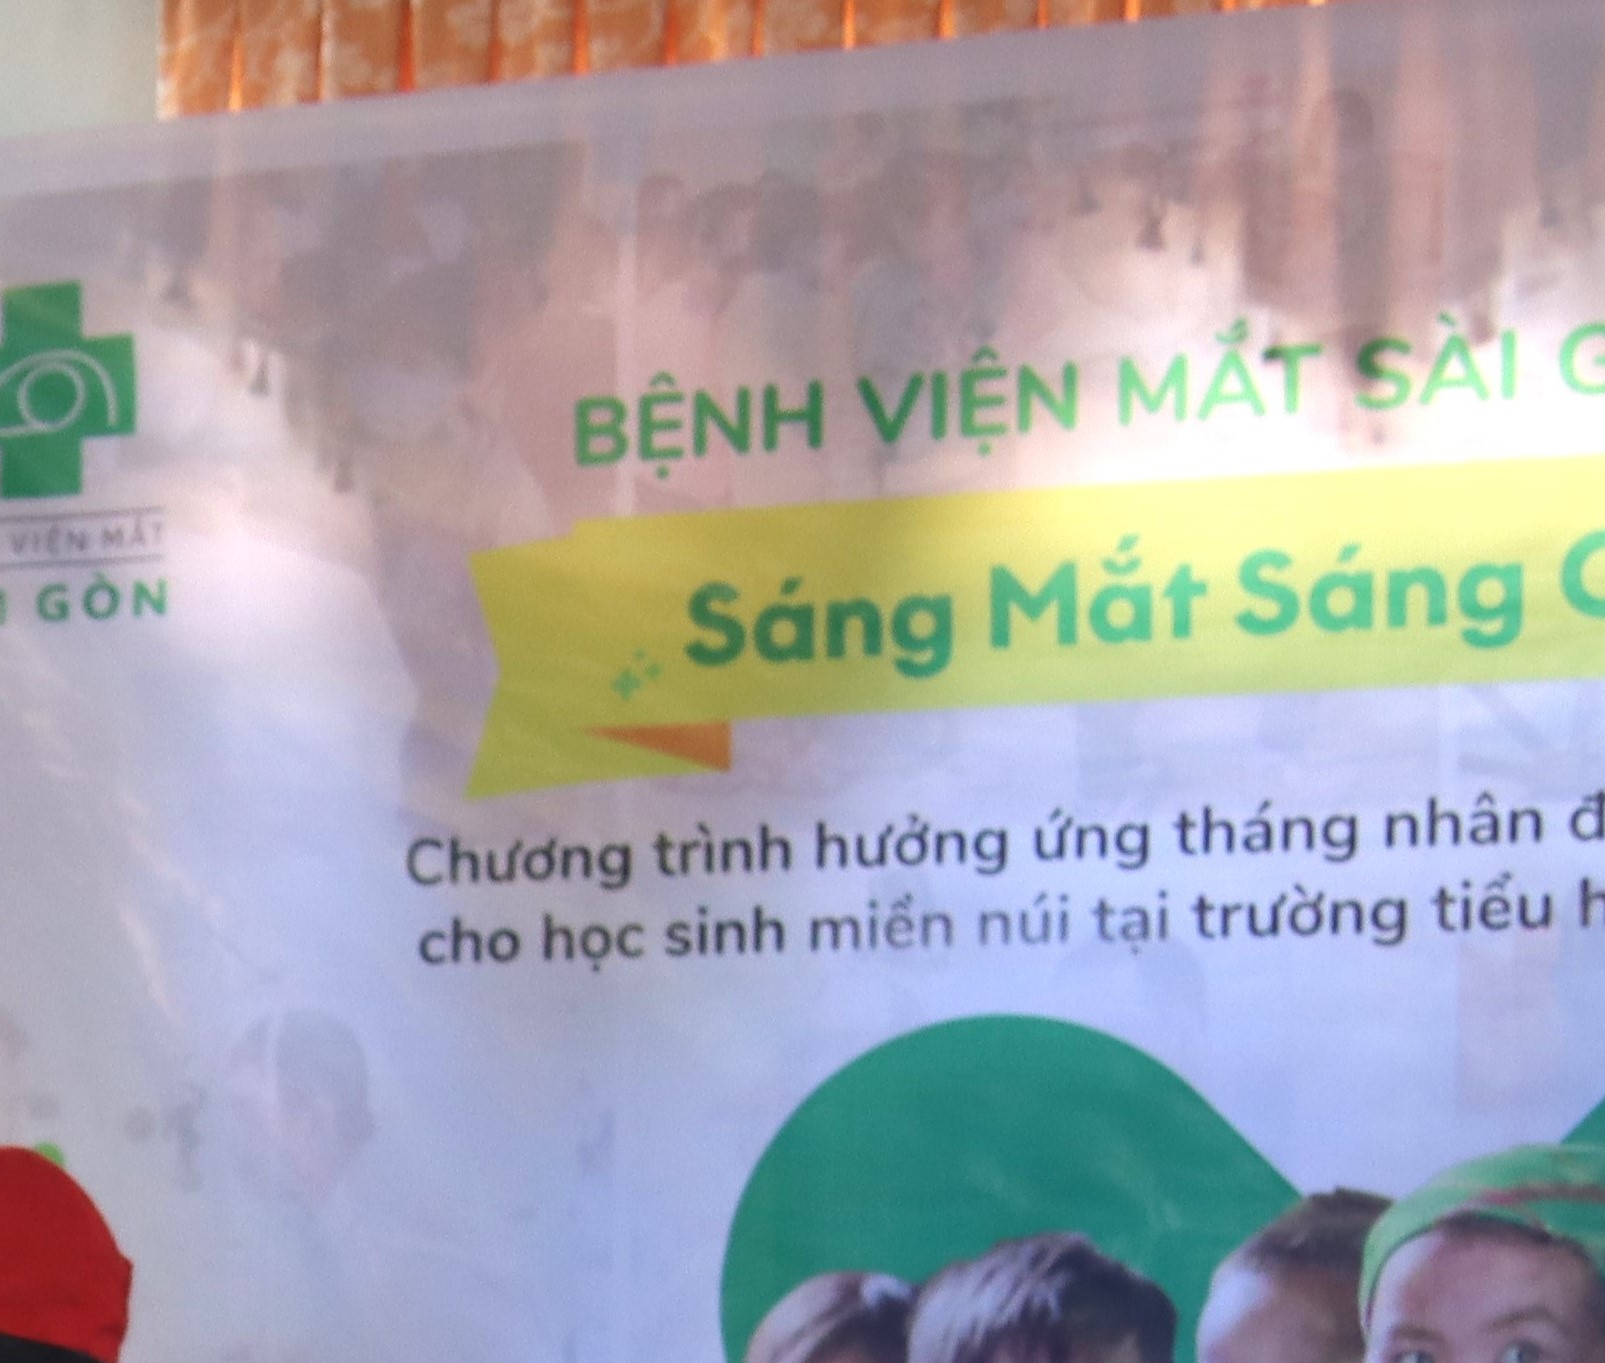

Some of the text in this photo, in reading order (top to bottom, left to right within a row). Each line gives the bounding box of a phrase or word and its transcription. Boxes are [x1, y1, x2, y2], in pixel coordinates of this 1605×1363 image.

[573, 372, 825, 479] BỆNH
[856, 347, 1079, 455] VIỆN
[1116, 317, 1321, 426] MẮT
[1355, 312, 1516, 412] SÀI
[36, 570, 168, 622] GÒN
[685, 577, 954, 679] Sáng
[989, 534, 1207, 649] Mắt
[1235, 544, 1524, 649] Sáng
[405, 837, 632, 897] Chương
[653, 821, 792, 877] trình
[814, 812, 1009, 884] hưởng
[1033, 802, 1151, 876] ứng
[1175, 800, 1359, 868] tháng
[1384, 790, 1544, 848] nhân
[419, 914, 520, 966] cho
[543, 910, 645, 970] học
[664, 906, 785, 957] sinh
[808, 893, 955, 951] miền
[978, 891, 1070, 946] núi
[1096, 890, 1170, 955] tại
[1192, 881, 1408, 946] trường
[1435, 874, 1554, 934] tiểu
